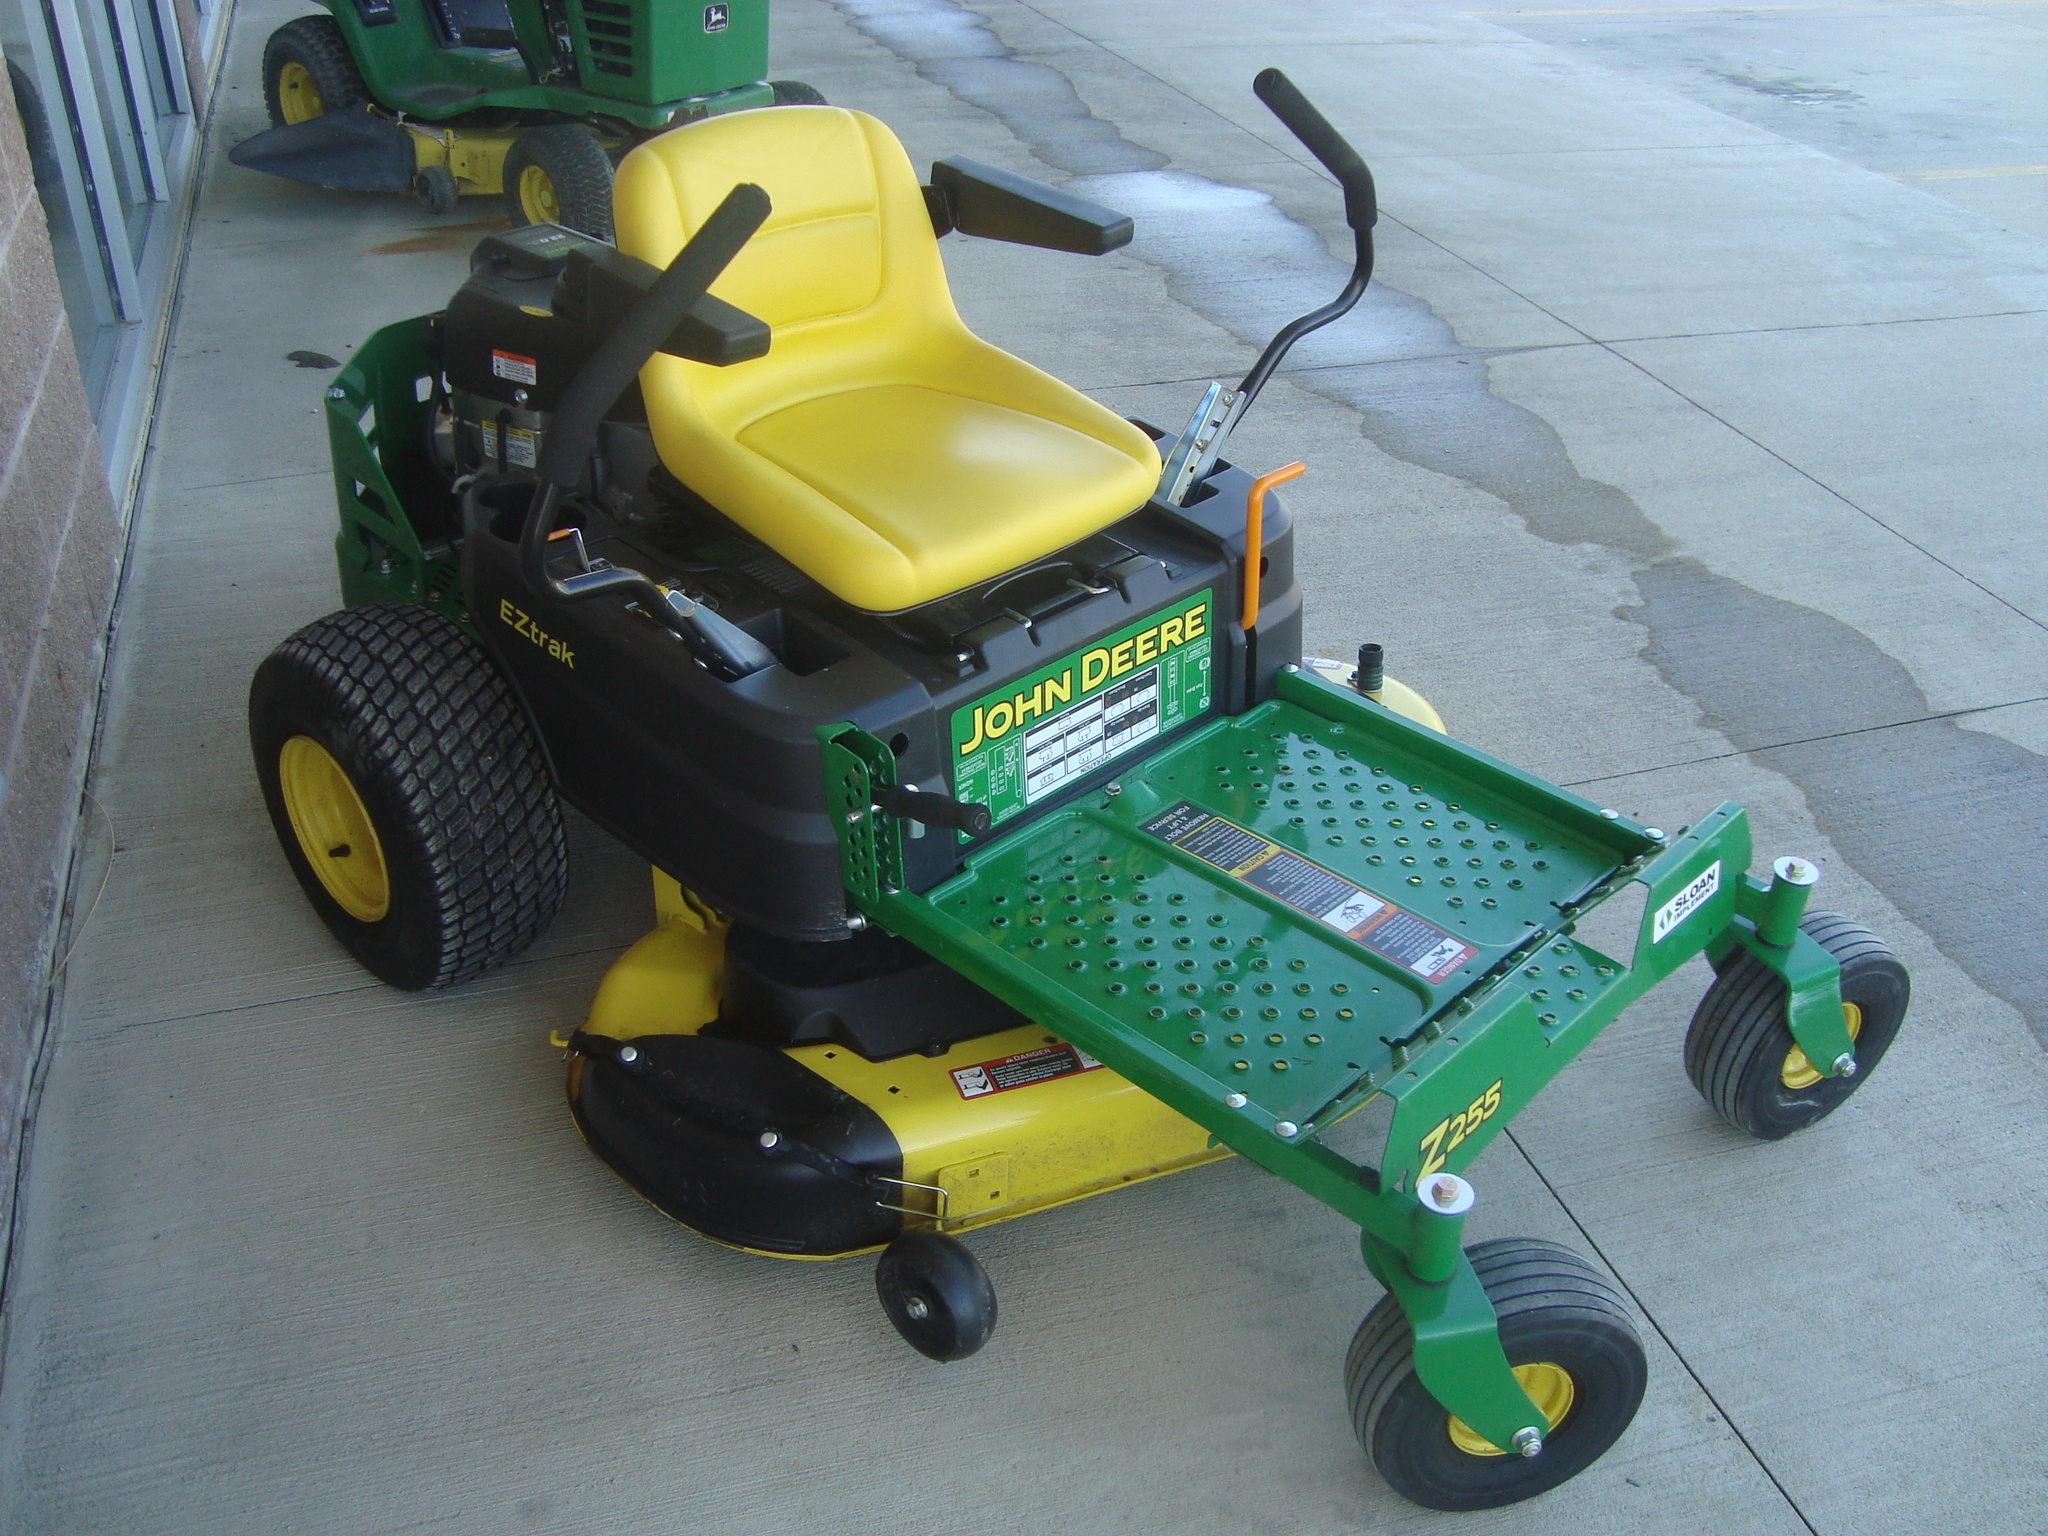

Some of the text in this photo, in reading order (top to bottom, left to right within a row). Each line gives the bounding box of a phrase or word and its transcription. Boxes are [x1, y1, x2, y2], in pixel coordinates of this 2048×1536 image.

[500, 598, 575, 669] EZtrak
[960, 603, 1206, 756] JOHN DEERE
[1080, 754, 1112, 774] OPERATION
[1144, 812, 1178, 832] SERVICE
[1161, 812, 1211, 841] REMOVE BOLT
[1164, 818, 1184, 830] LIFT
[1236, 853, 1266, 872] CAUTION
[1673, 882, 1715, 922] IMPLEMENT
[1674, 868, 1716, 912] SLOAN
[1013, 1049, 1051, 1061] DANGER
[1415, 1076, 1504, 1188] Z255
